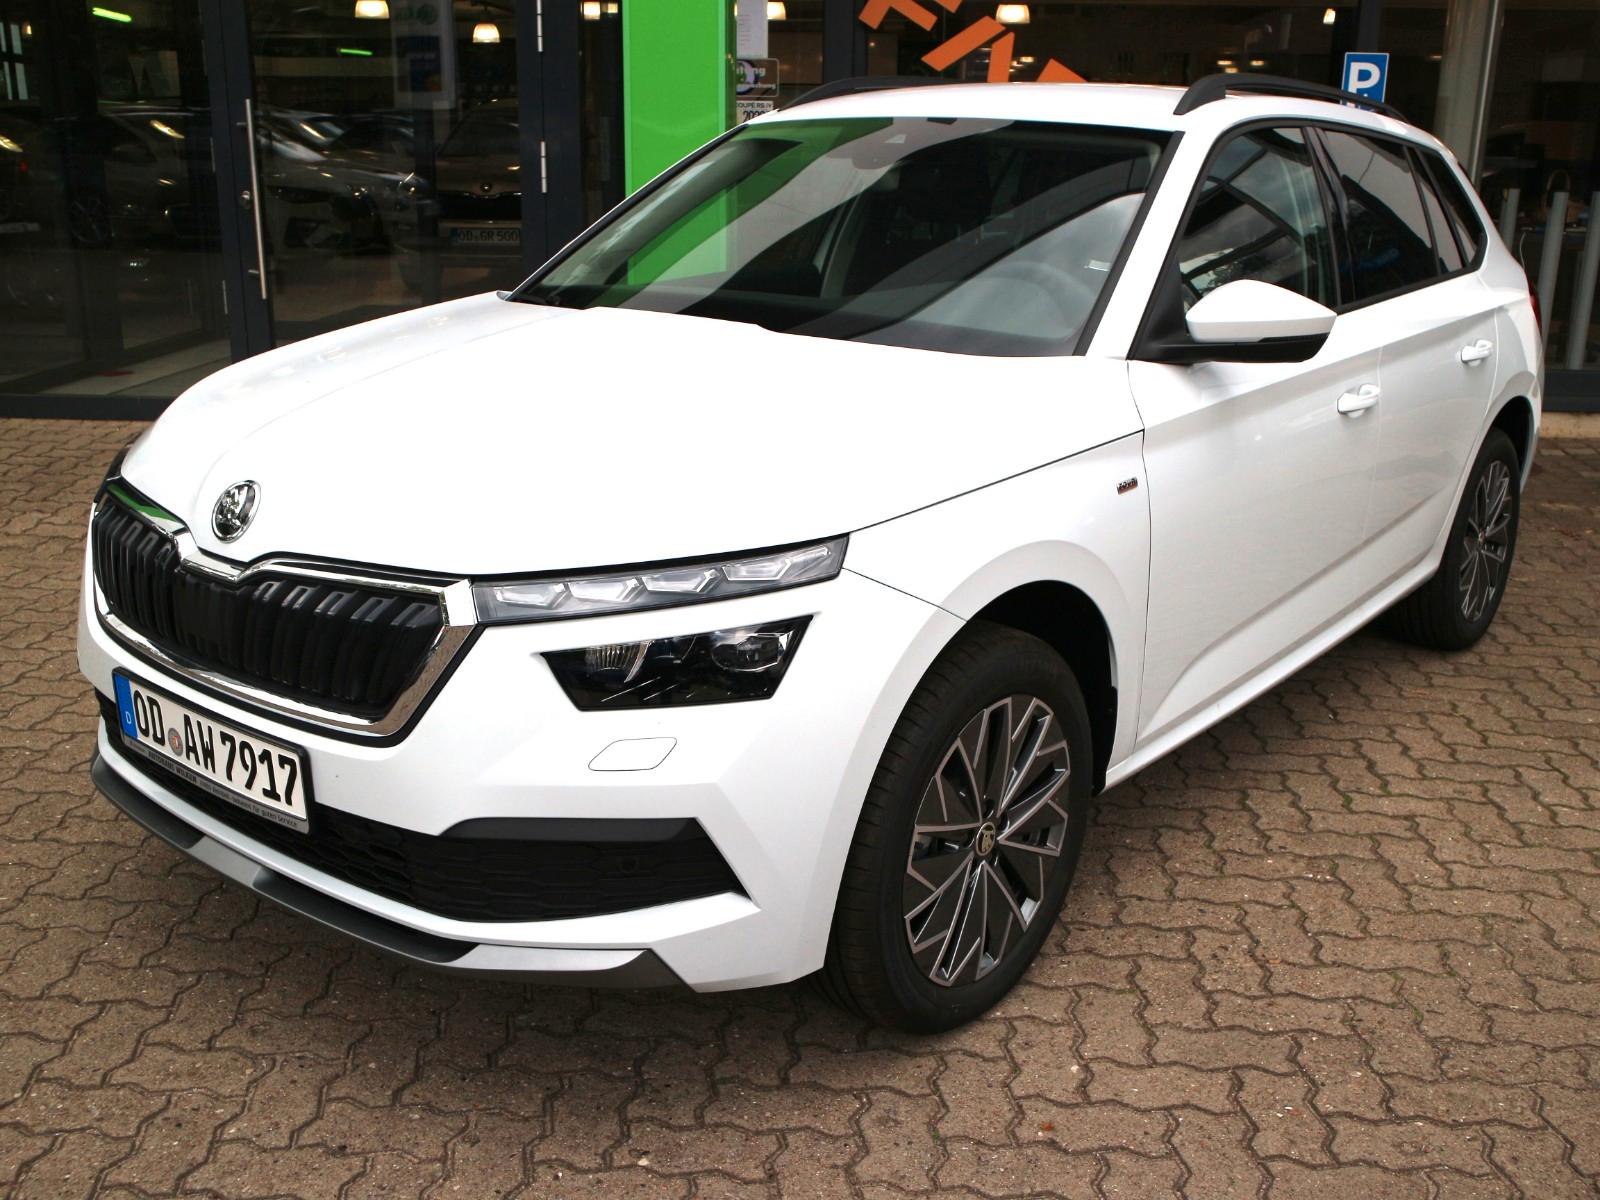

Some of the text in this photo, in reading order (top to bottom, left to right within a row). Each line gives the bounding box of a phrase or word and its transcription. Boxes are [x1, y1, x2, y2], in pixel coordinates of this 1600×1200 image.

[1347, 62, 1380, 95] P
[458, 230, 473, 242] OD
[133, 690, 297, 806] OD AW 7917
